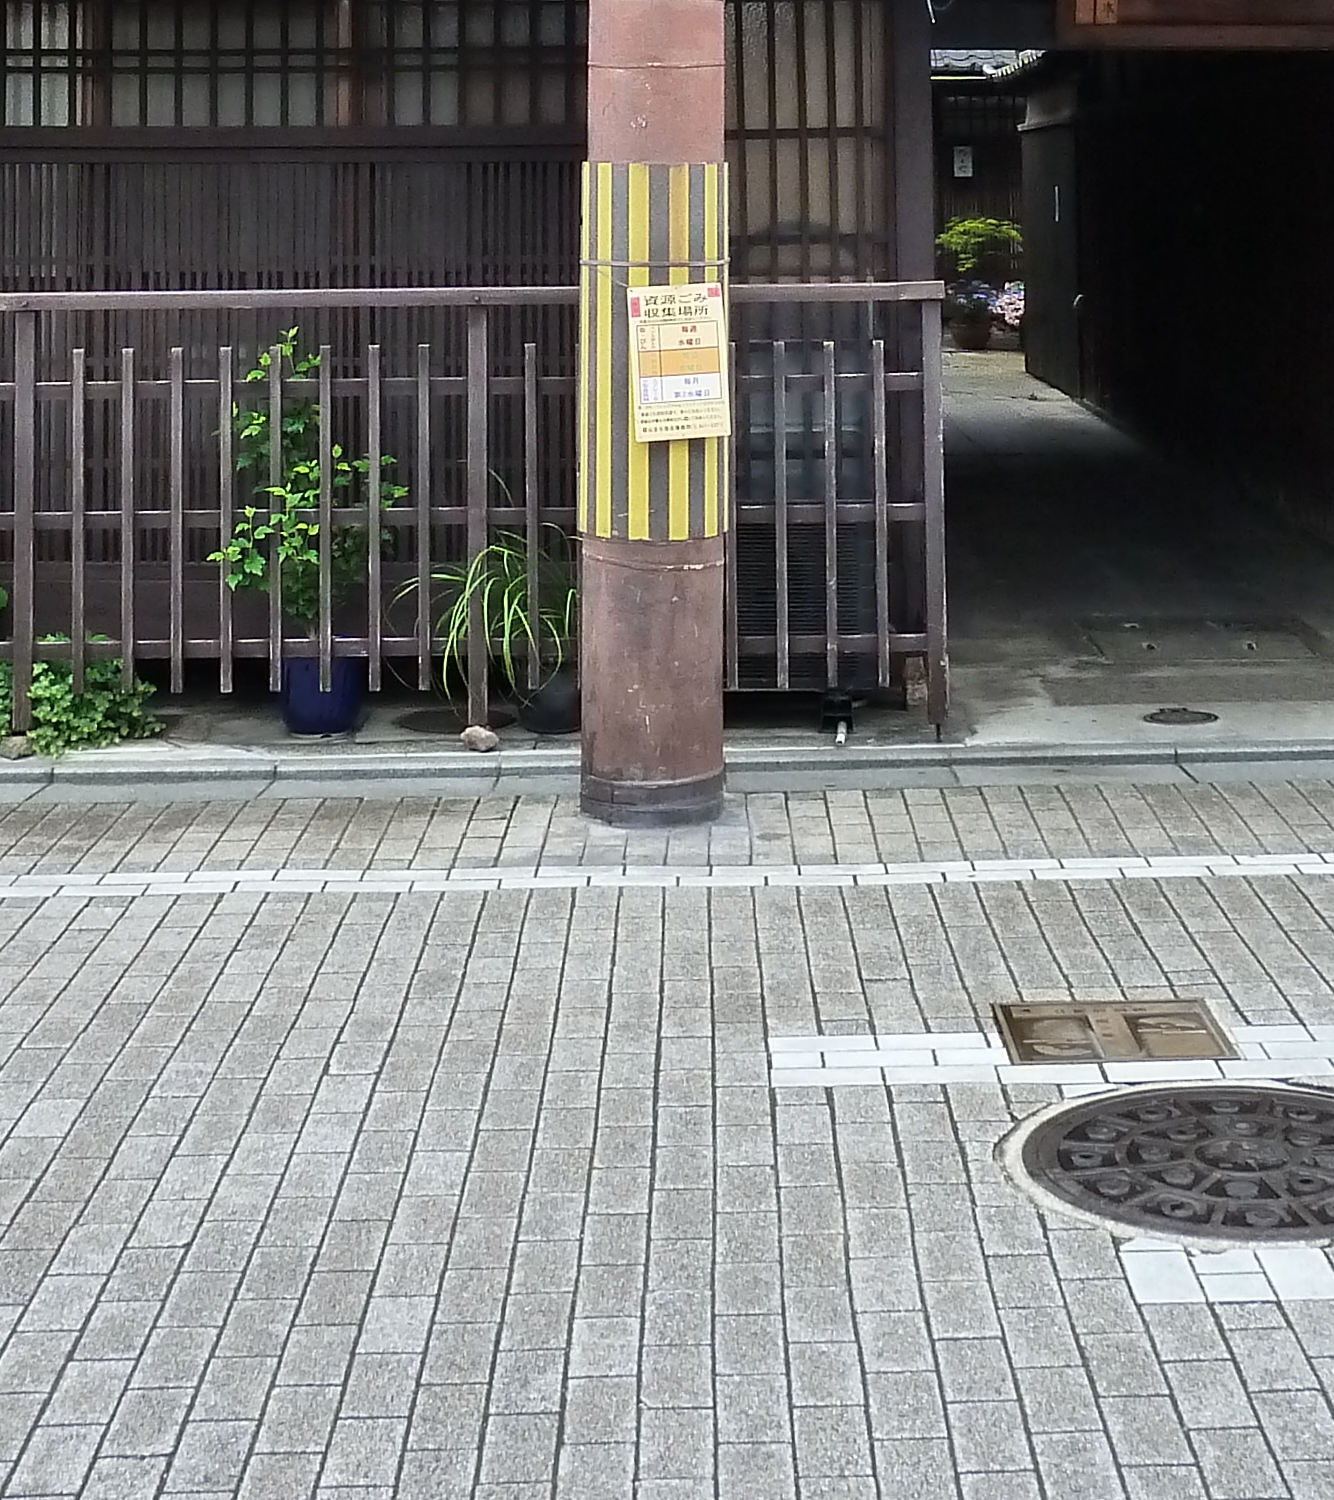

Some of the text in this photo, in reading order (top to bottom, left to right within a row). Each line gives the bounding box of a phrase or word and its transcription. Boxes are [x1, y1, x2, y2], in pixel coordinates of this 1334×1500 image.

[643, 293, 708, 307] 資源ごみ
[643, 304, 709, 319] 収集場所
